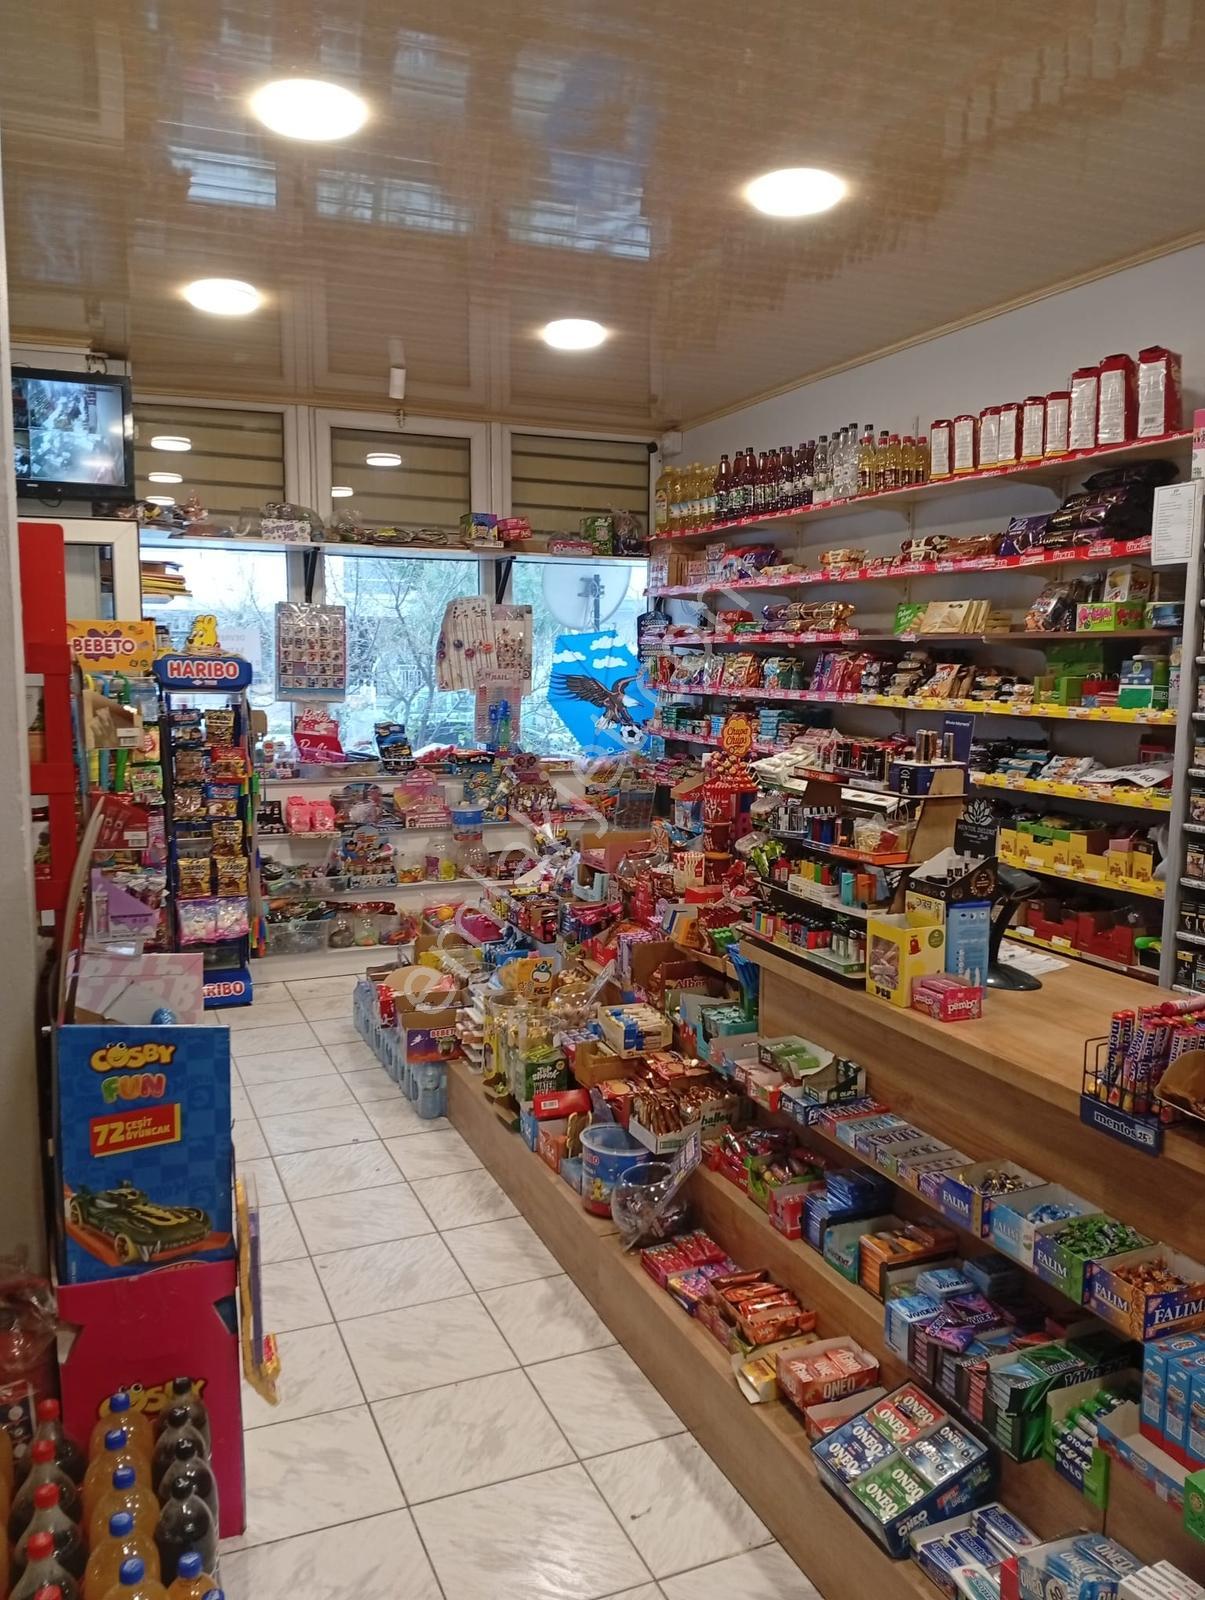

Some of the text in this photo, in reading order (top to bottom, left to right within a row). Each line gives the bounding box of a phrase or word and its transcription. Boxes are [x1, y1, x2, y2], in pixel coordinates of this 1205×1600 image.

[72, 637, 137, 655] BEBETO
[168, 660, 239, 680] HARIBO
[429, 1027, 459, 1039] BEBET
[89, 1042, 177, 1073] COSBY
[101, 1073, 167, 1104] FUN
[93, 1120, 127, 1146] 72
[1095, 1111, 1138, 1139] mentos
[942, 1190, 970, 1215] FALIM
[1037, 1249, 1068, 1278] FALIM
[1095, 1281, 1129, 1312] FALIM
[1153, 1298, 1204, 1324] FALIM
[823, 1376, 856, 1399] ONEO
[878, 1407, 911, 1440] ONEO
[902, 1395, 936, 1427] ONEO
[852, 1425, 884, 1458] ONEO
[914, 1440, 941, 1465] ONEO
[940, 1426, 966, 1450] ONEO
[828, 1441, 861, 1477] ONEO
[891, 1468, 925, 1501] ONEO
[865, 1482, 899, 1518] ONEO
[897, 1509, 928, 1537] ONEO
[959, 1531, 996, 1561] mentos
[1094, 1543, 1135, 1572] ONEO
